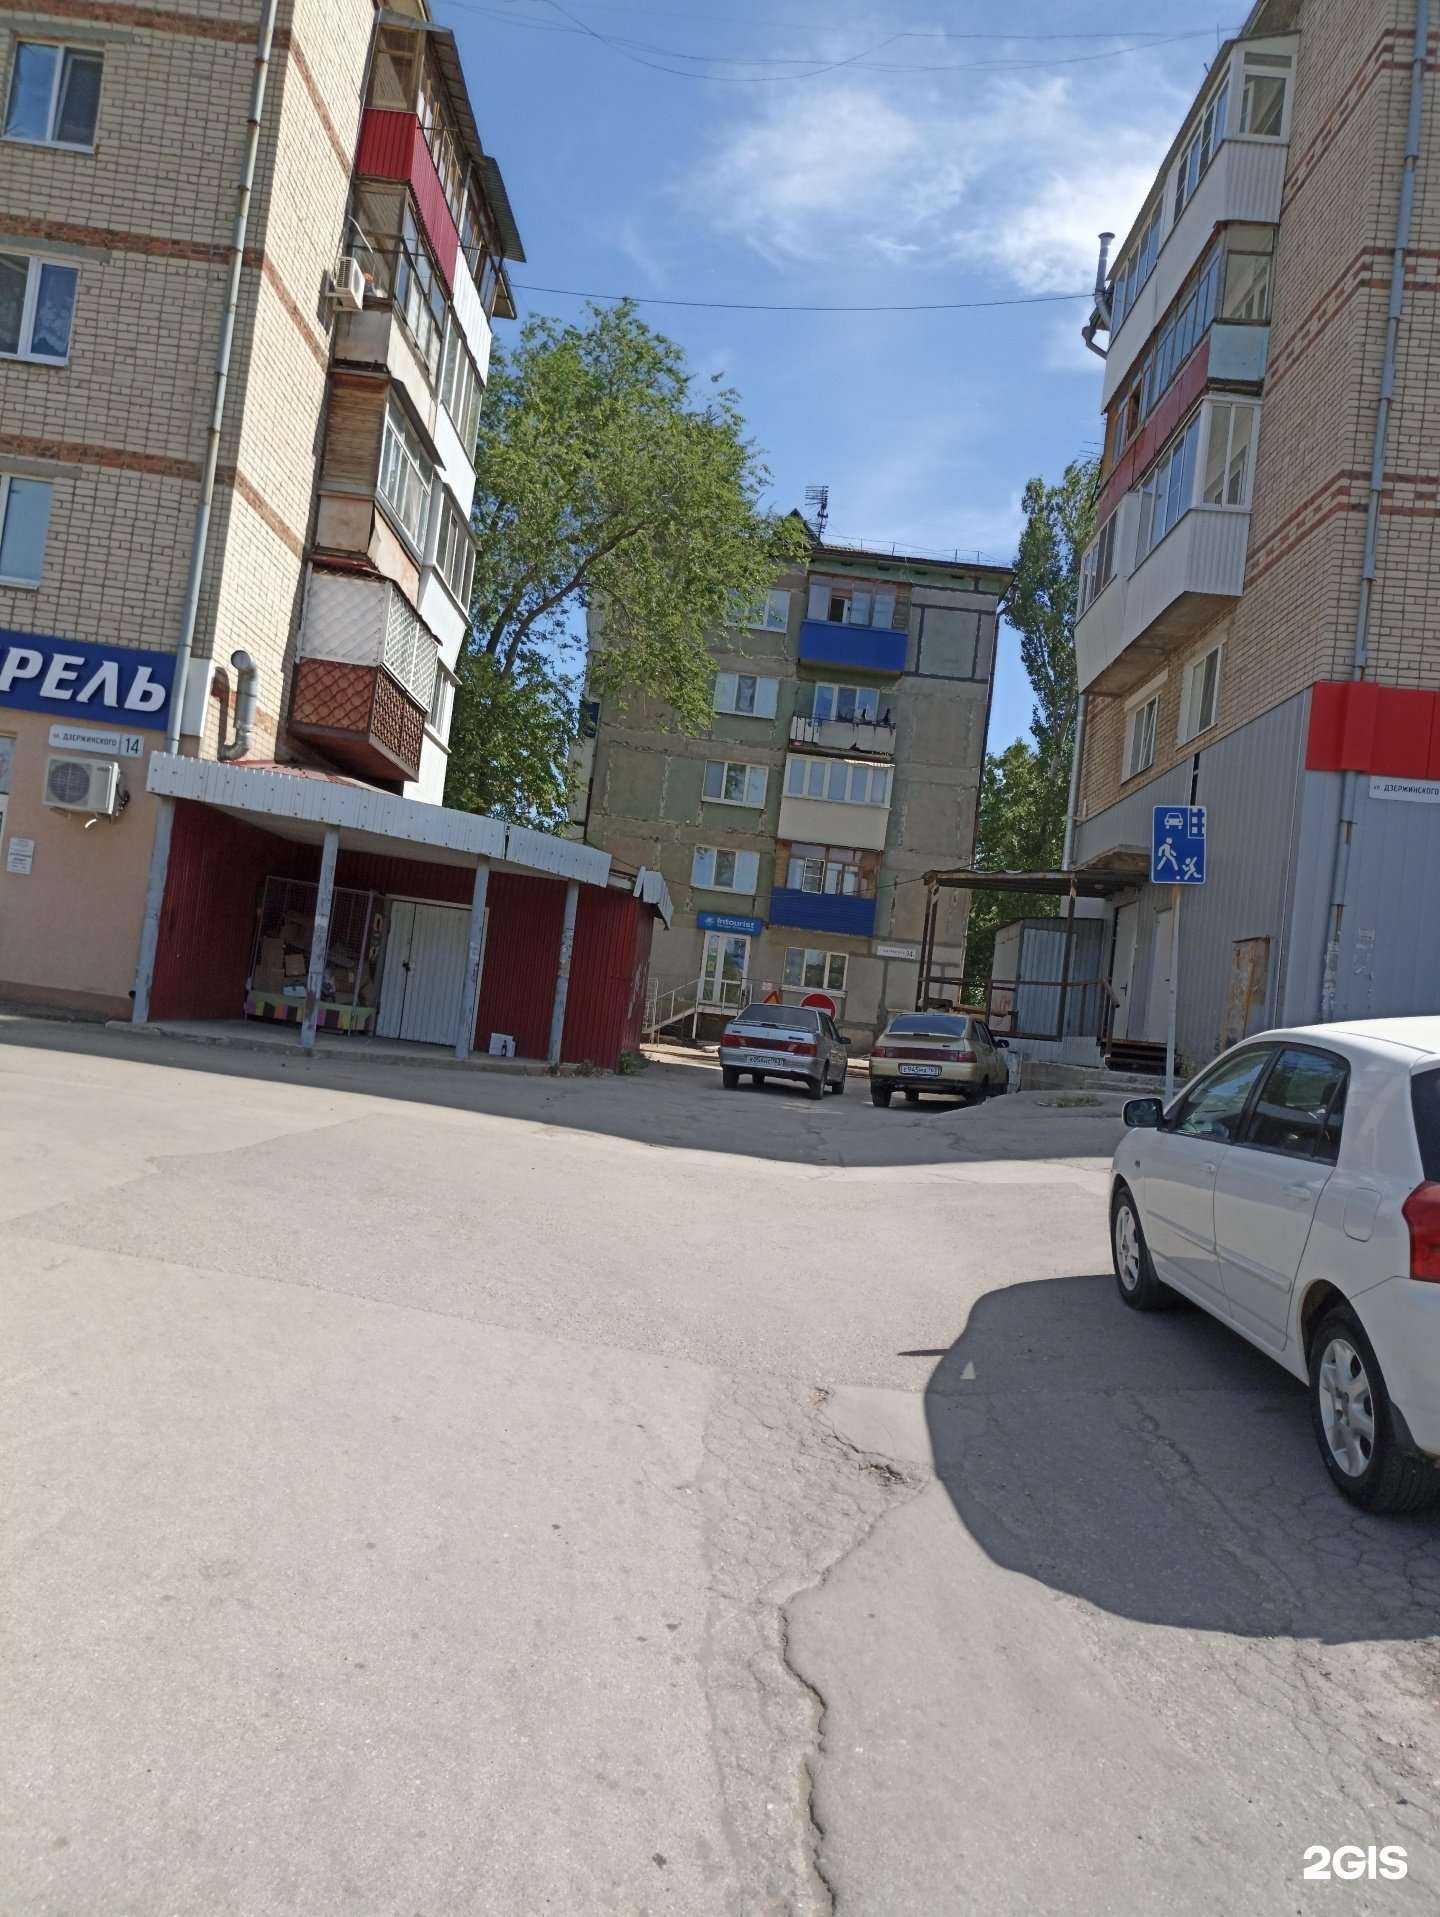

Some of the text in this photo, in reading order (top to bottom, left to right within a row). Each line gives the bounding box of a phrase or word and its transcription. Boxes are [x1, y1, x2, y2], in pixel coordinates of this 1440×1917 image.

[0, 646, 167, 712] РЕЛЬ
[63, 732, 118, 746] ДЗЕРЖИНСКОГО
[125, 737, 140, 754] 14
[1384, 784, 1440, 796] ДЗЕРЖИНСКОГО
